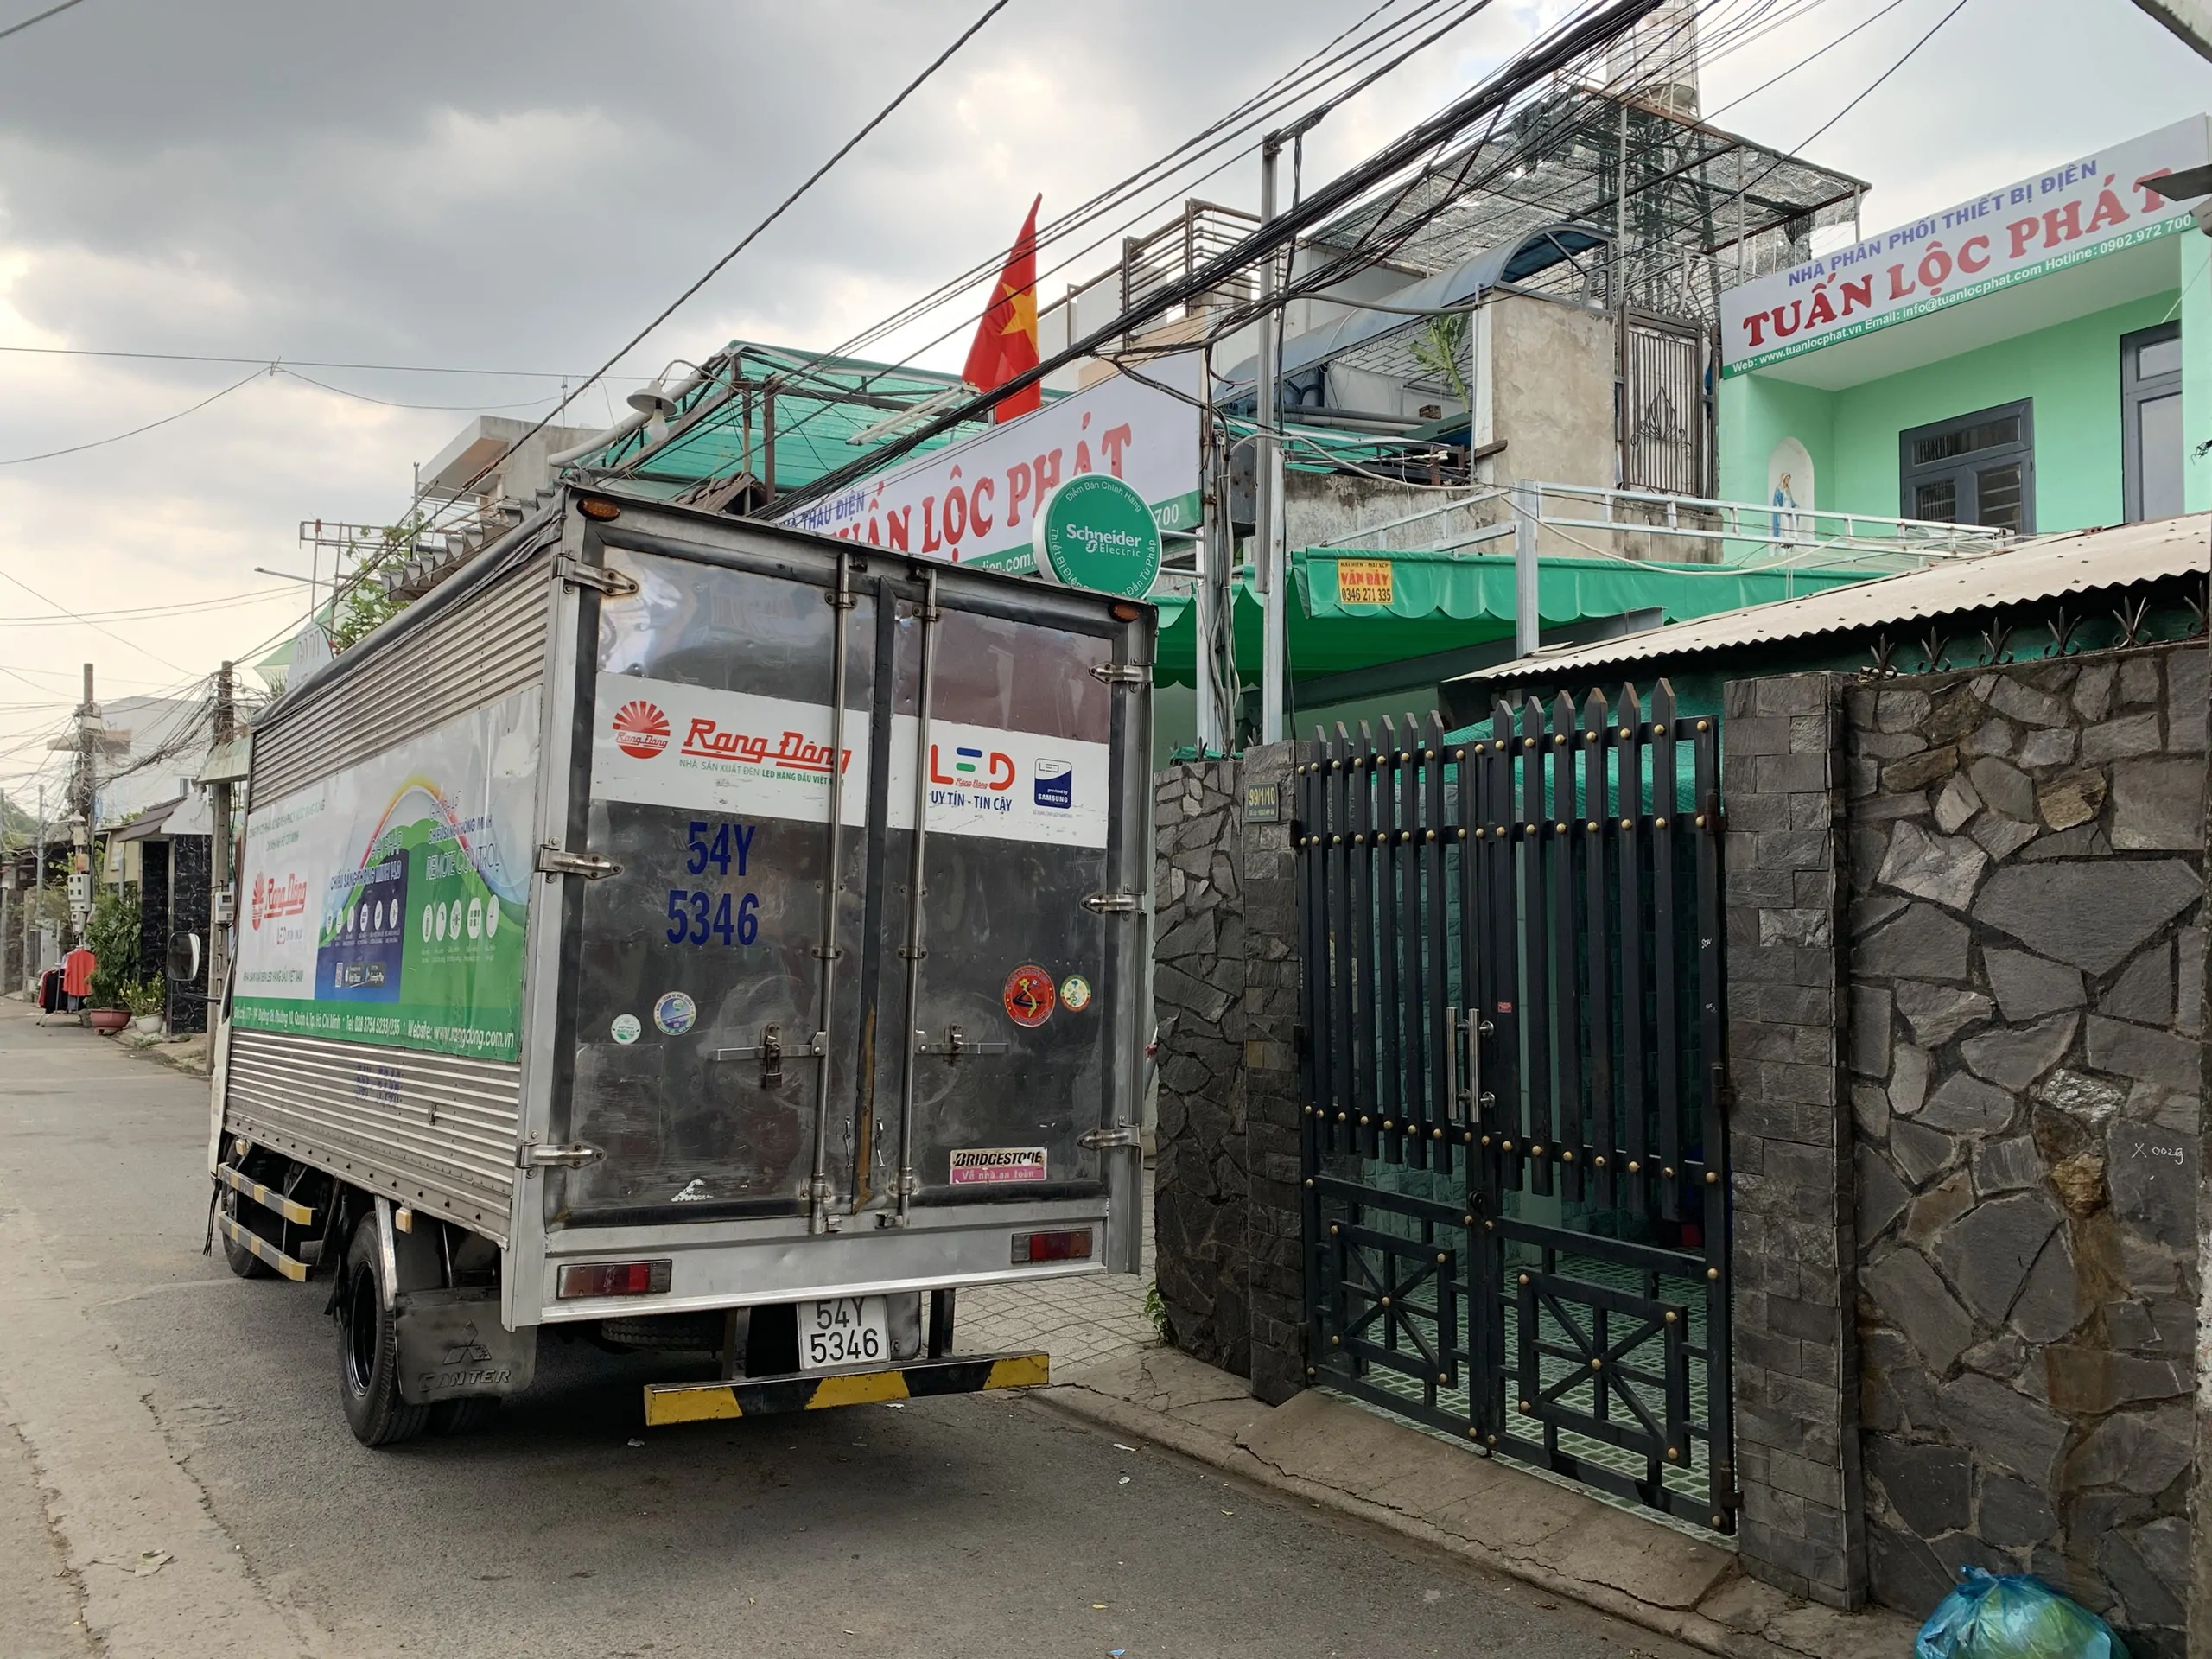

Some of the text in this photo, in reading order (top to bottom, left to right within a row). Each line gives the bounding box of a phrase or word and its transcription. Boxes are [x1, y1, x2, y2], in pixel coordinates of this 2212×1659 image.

[1789, 261, 1825, 287] NHÀ
[1831, 239, 1882, 271] PHÂN
[1889, 216, 1936, 251] PHỐI
[1942, 193, 2005, 230] THIẾT
[2010, 183, 2033, 206] BỊ
[1743, 167, 2173, 347] TUẤN LỘC PHÁT
[1732, 213, 2192, 373] Web: www.tuanlocphat.vn Email: info@tuanlocphat.com Hotline: 0902.972 700
[830, 480, 912, 552] ẤN
[921, 464, 995, 563] LỘC
[836, 489, 865, 522] ĐIỆN
[1066, 523, 1142, 548] Schneider
[1099, 543, 1141, 558] Electric
[1340, 569, 1364, 585] VĂN
[1342, 588, 1391, 601] 0346 271 335
[761, 769, 775, 778] LED
[931, 791, 945, 804] UY
[947, 790, 965, 807] TÍN
[974, 795, 991, 810] TIN
[994, 796, 1012, 815] CẬY
[1038, 793, 1068, 803] SAMSUNG
[687, 822, 756, 876] 54Y
[666, 890, 760, 946] 5346
[816, 1297, 865, 1330] 54Y
[810, 1328, 879, 1363] 5346
[419, 1369, 512, 1393] CANTER
